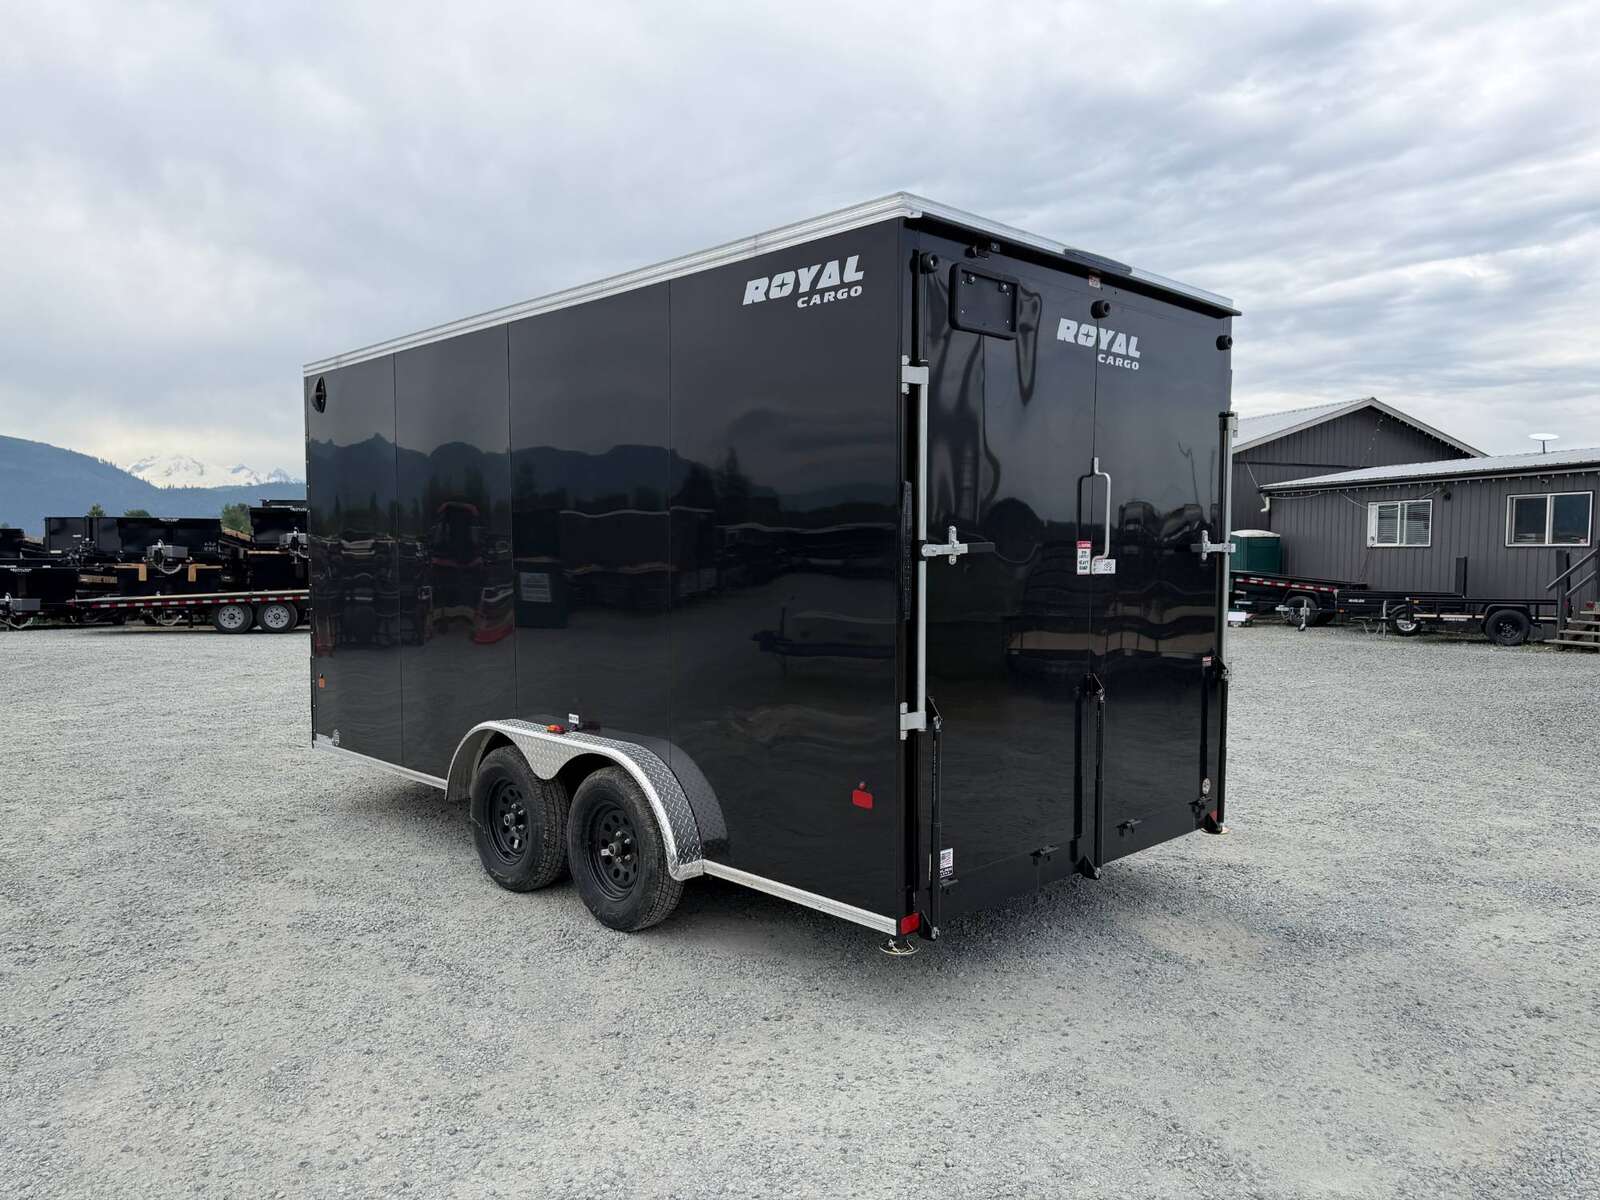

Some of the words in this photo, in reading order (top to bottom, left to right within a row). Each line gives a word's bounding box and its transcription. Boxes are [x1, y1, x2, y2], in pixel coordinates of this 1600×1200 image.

[742, 254, 865, 306] ROYAL
[796, 285, 863, 309] CARGO
[1056, 317, 1141, 359] ROYAL
[1097, 353, 1140, 371] CARGO
